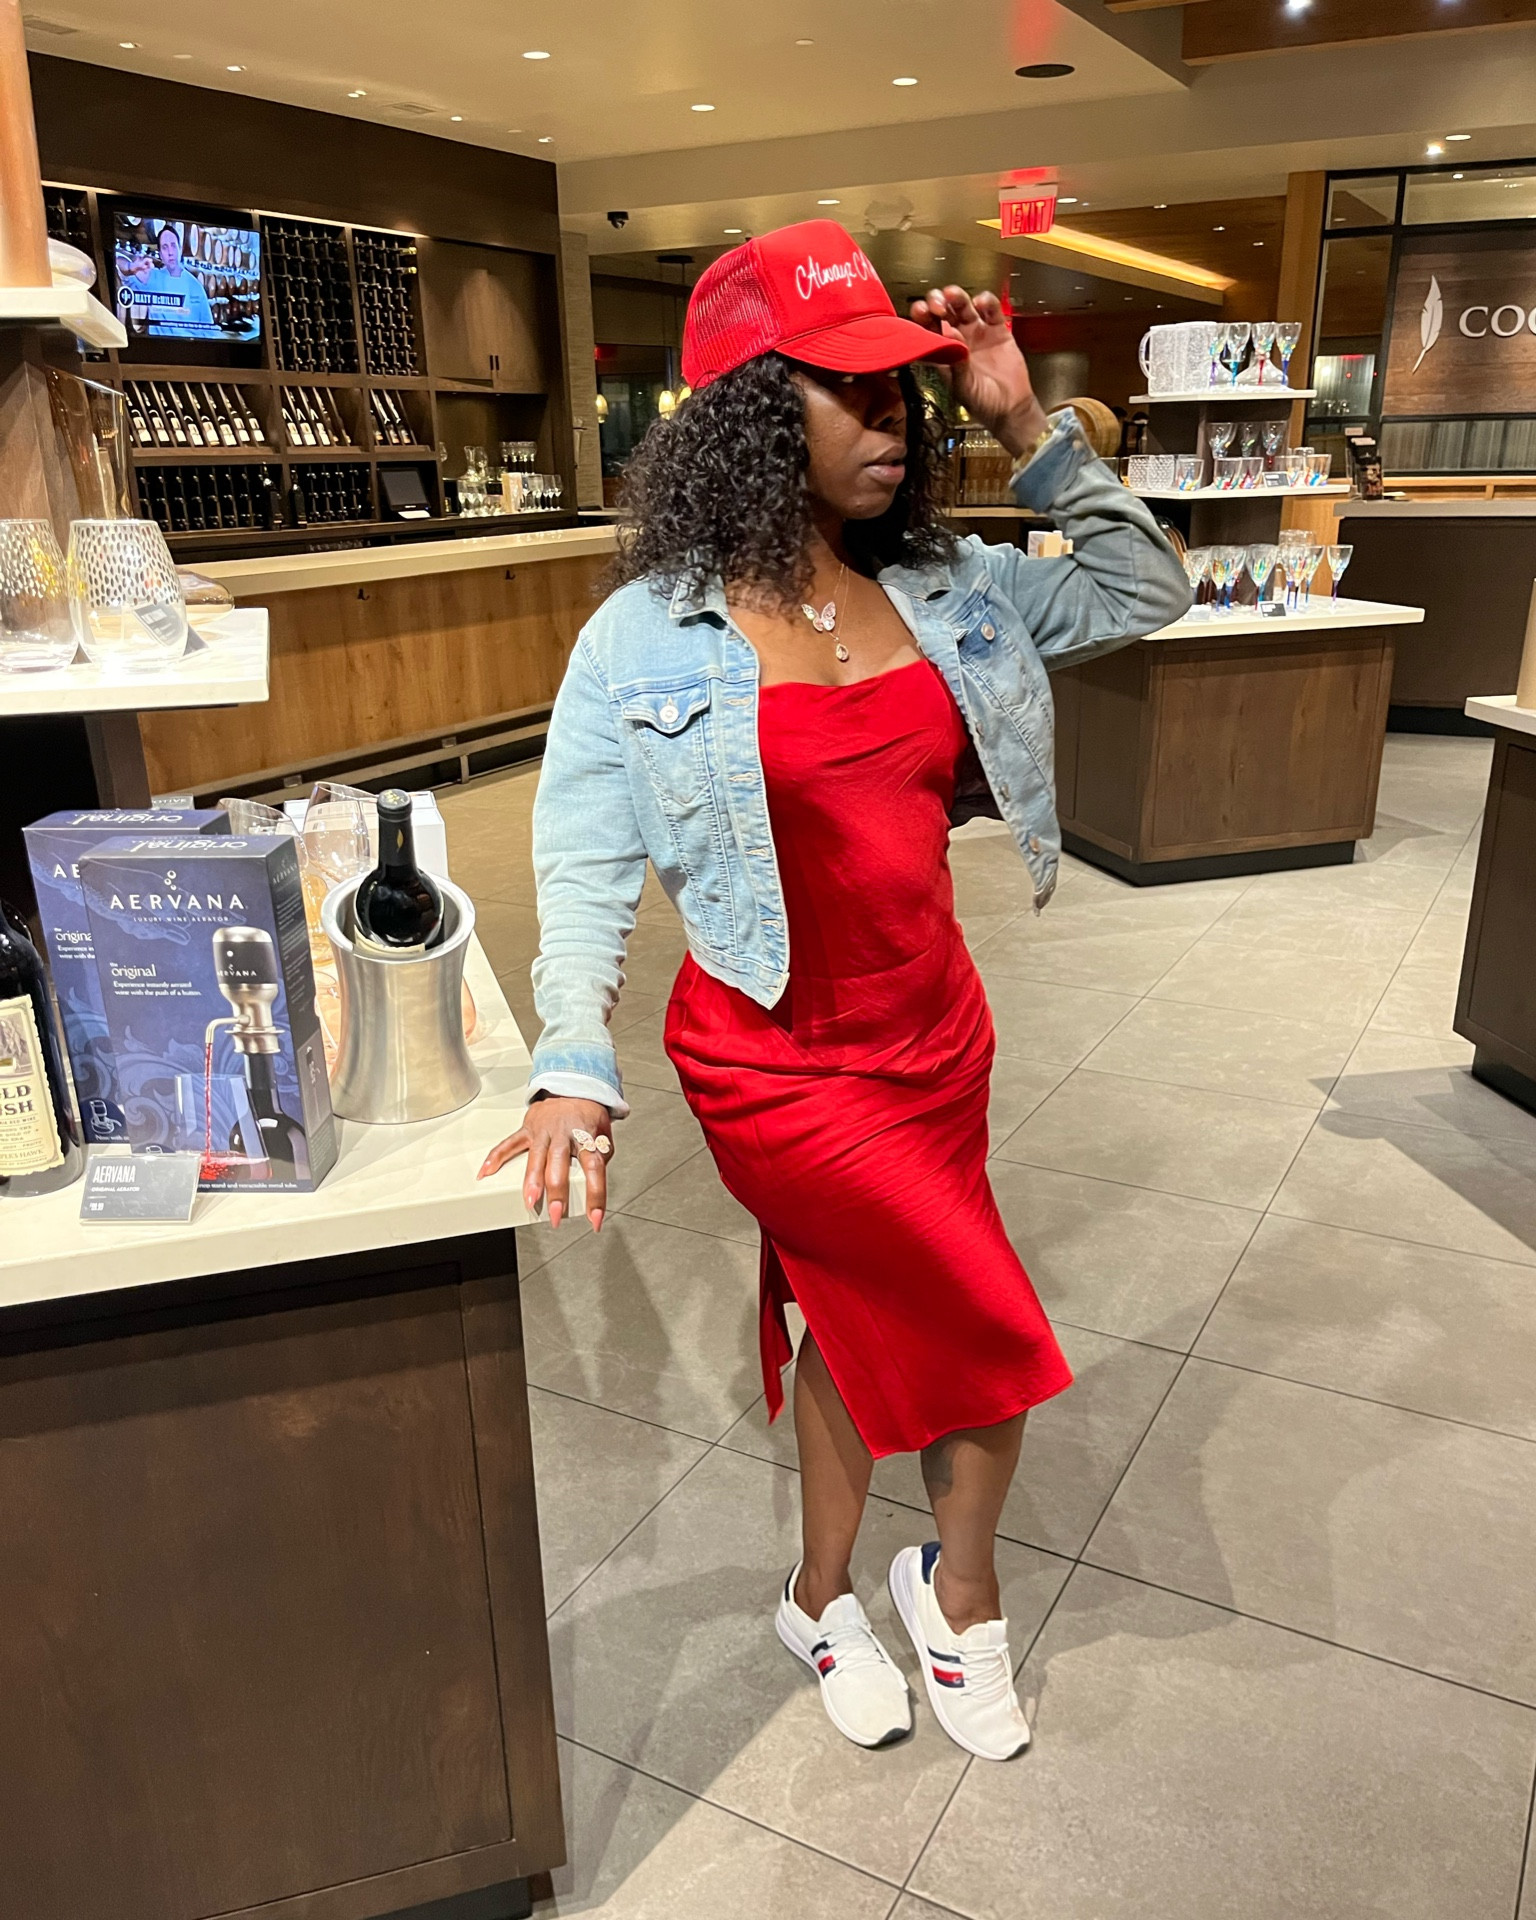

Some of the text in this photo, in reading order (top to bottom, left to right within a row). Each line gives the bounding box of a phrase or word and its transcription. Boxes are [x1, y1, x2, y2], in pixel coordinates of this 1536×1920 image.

[1011, 201, 1045, 233] EXIT
[796, 255, 857, 300] Always
[135, 293, 151, 304] MATT
[1459, 304, 1536, 338] CO
[129, 838, 248, 852] original
[110, 894, 244, 910] AERVANA
[111, 963, 157, 979] original
[0, 1085, 31, 1099] LD
[92, 1165, 136, 1183] AERVANA
